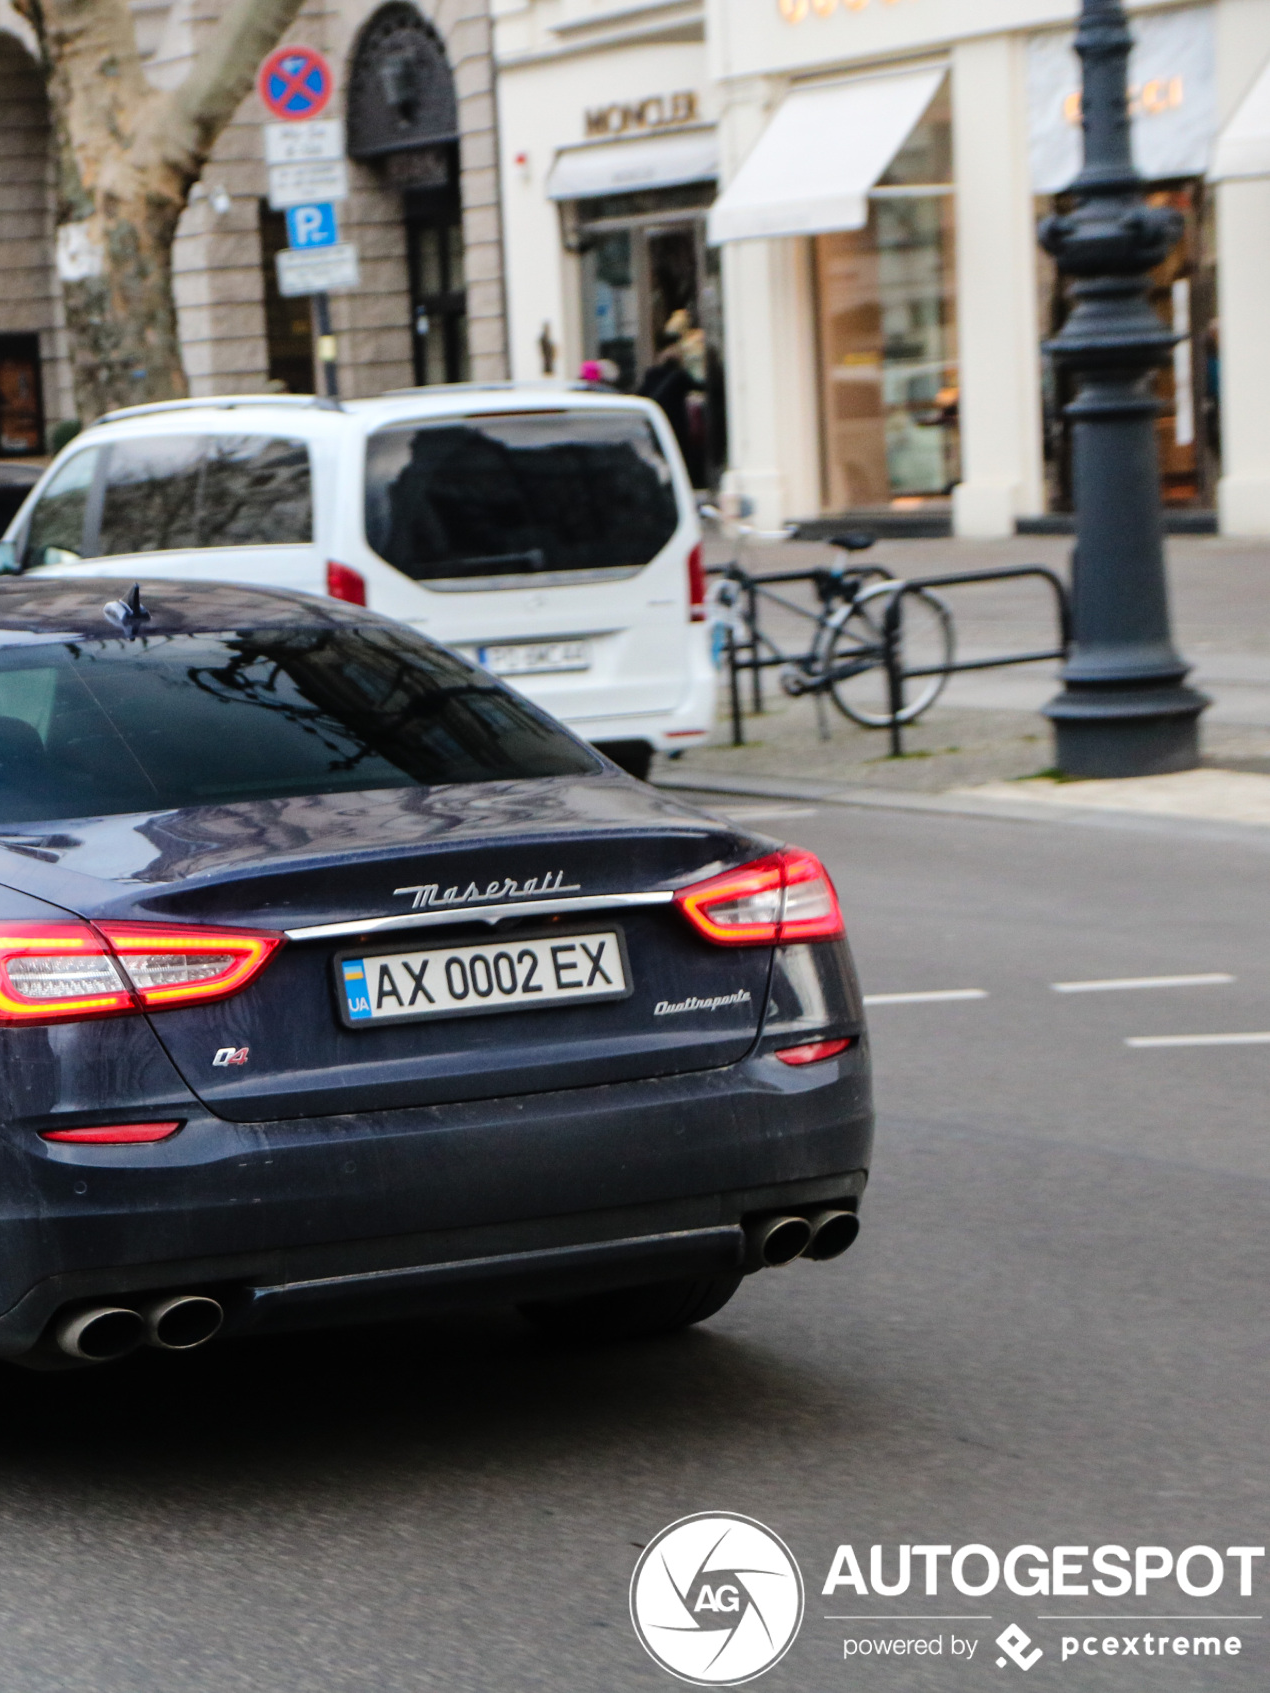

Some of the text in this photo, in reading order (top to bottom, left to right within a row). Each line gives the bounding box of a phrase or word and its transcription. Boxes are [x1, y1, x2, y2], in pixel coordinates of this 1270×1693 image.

[584, 90, 698, 136] MONCLER
[295, 206, 323, 245] P
[393, 870, 581, 909] Maserati
[376, 940, 613, 1010] AX 0002 EX
[347, 997, 370, 1012] UA
[653, 988, 752, 1015] Quattroporte
[212, 1046, 250, 1067] Q4
